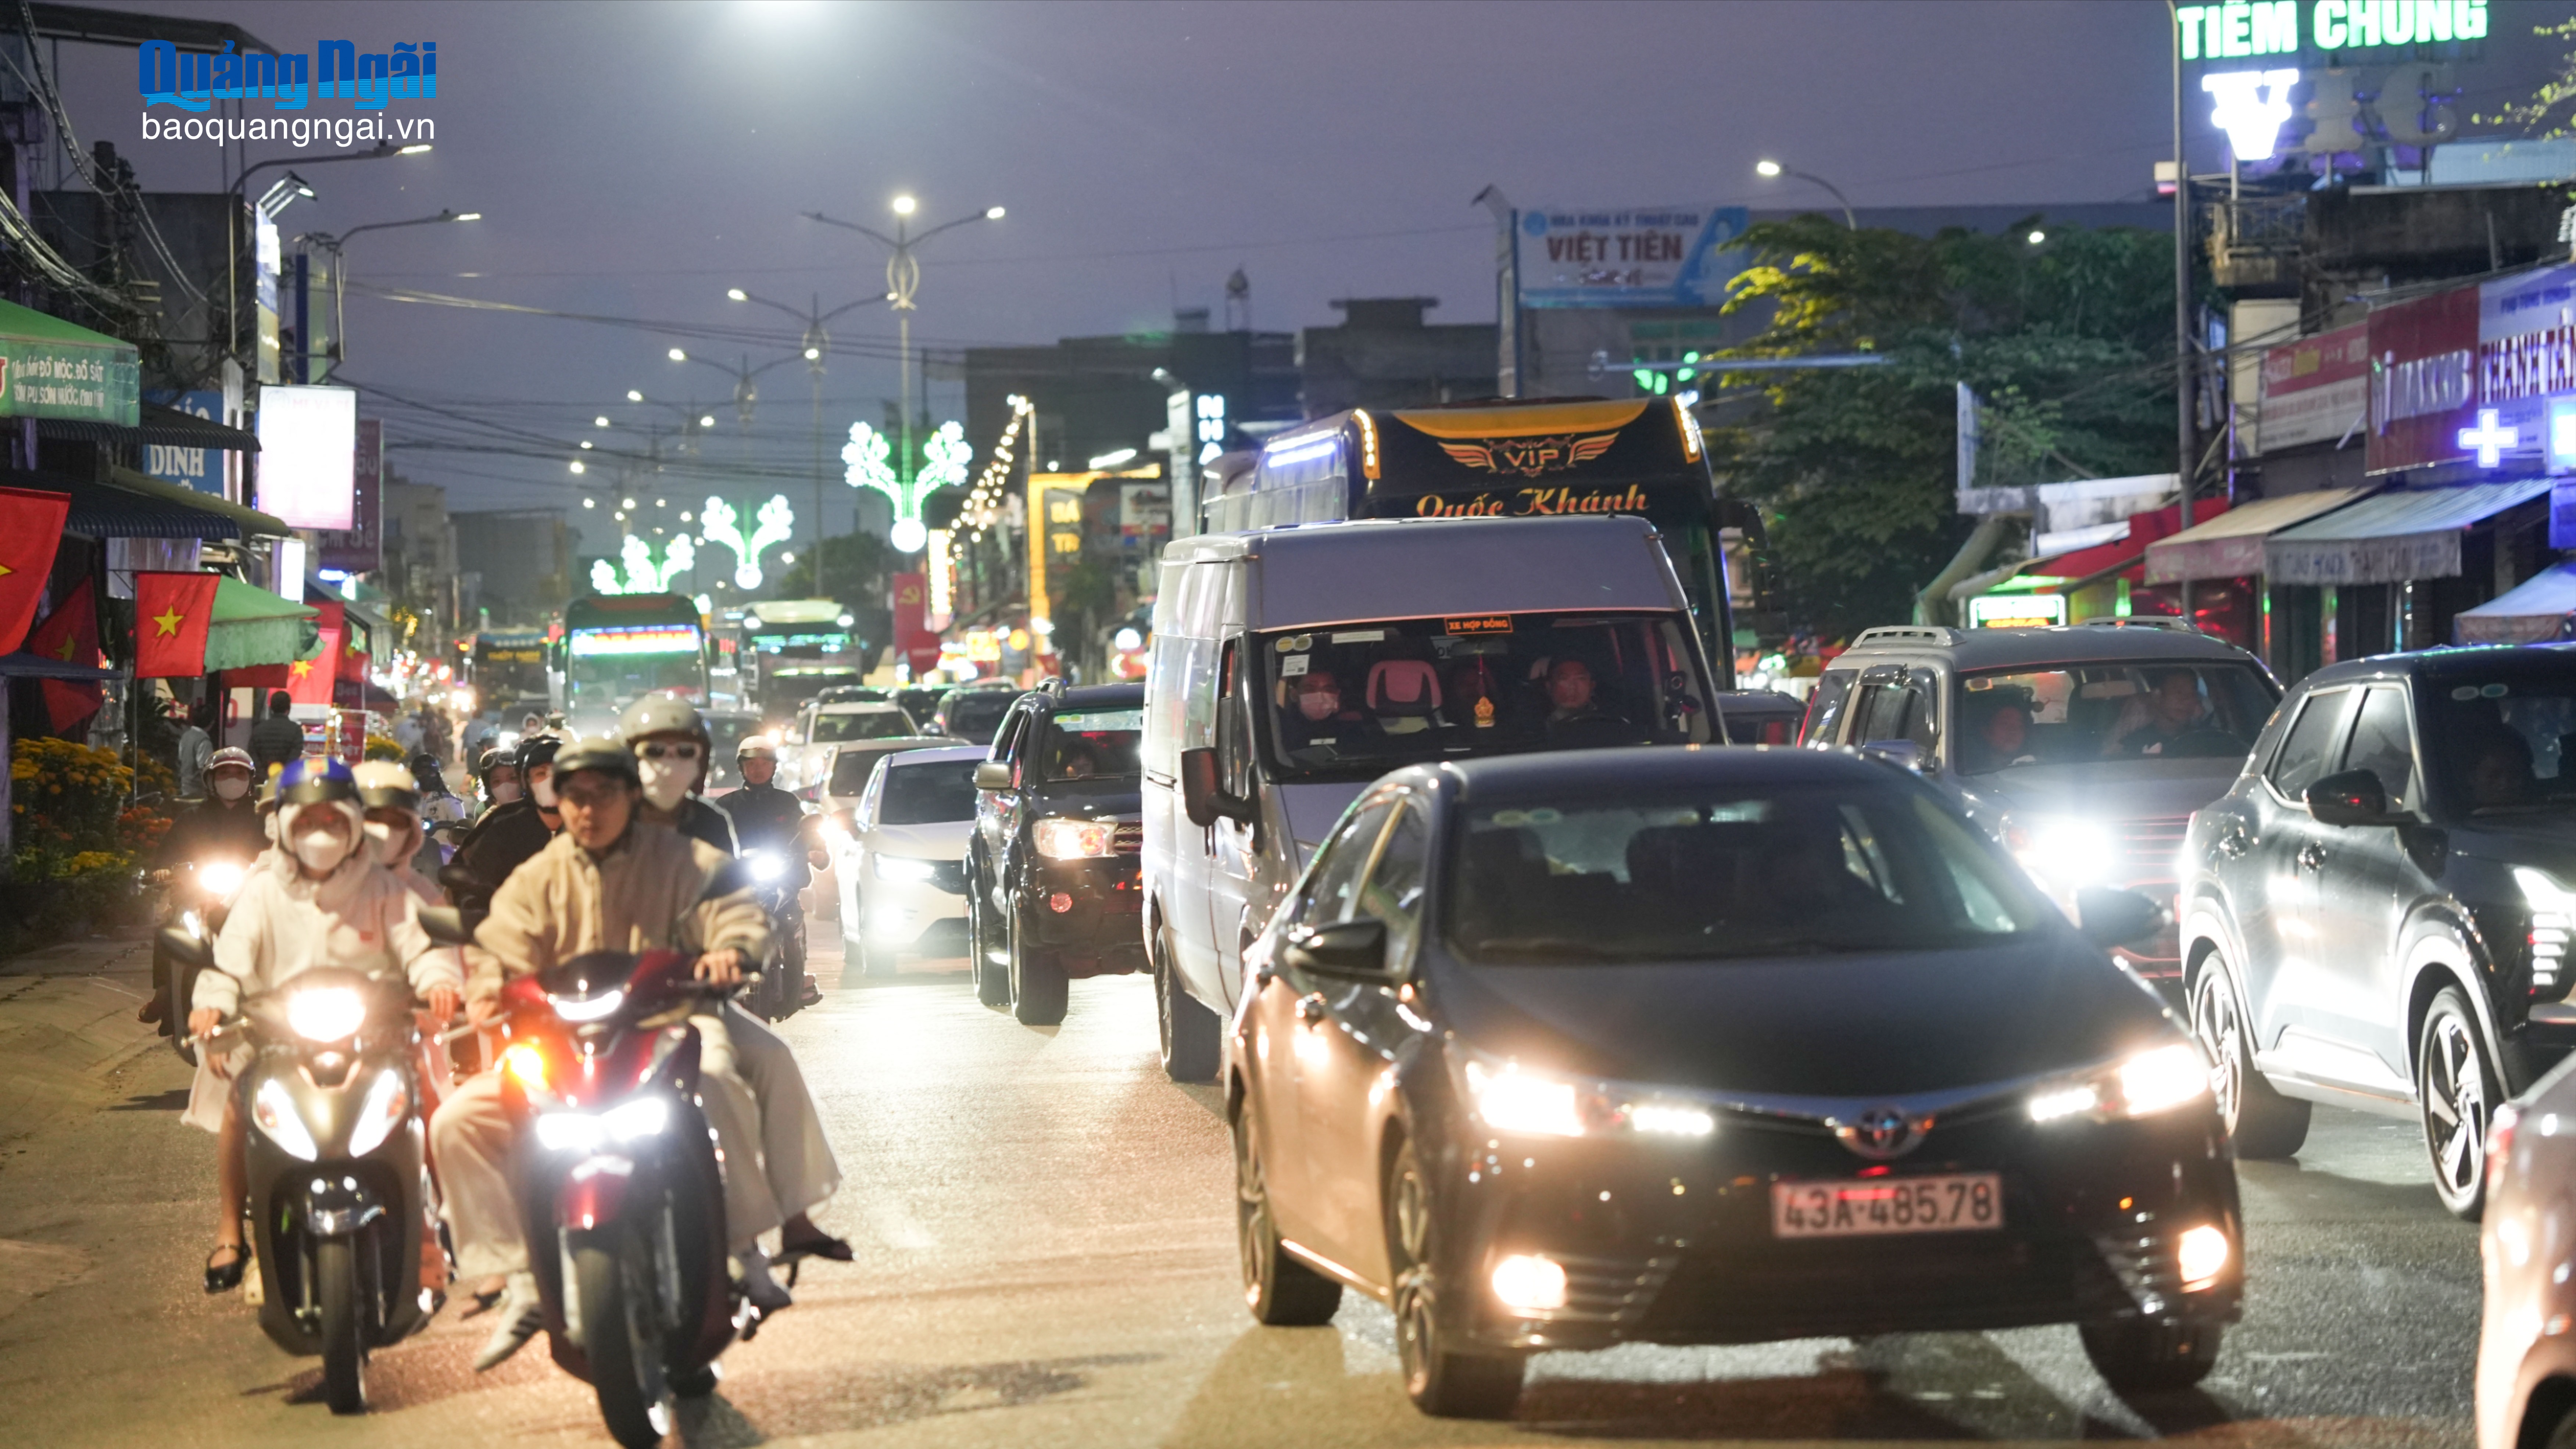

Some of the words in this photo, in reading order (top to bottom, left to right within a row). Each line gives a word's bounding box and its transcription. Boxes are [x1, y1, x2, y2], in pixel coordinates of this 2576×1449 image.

[1417, 493, 1504, 516] Quốc
[1514, 484, 1650, 515] Khánh
[1449, 622, 1461, 630] XE
[1463, 620, 1481, 631] HỢP
